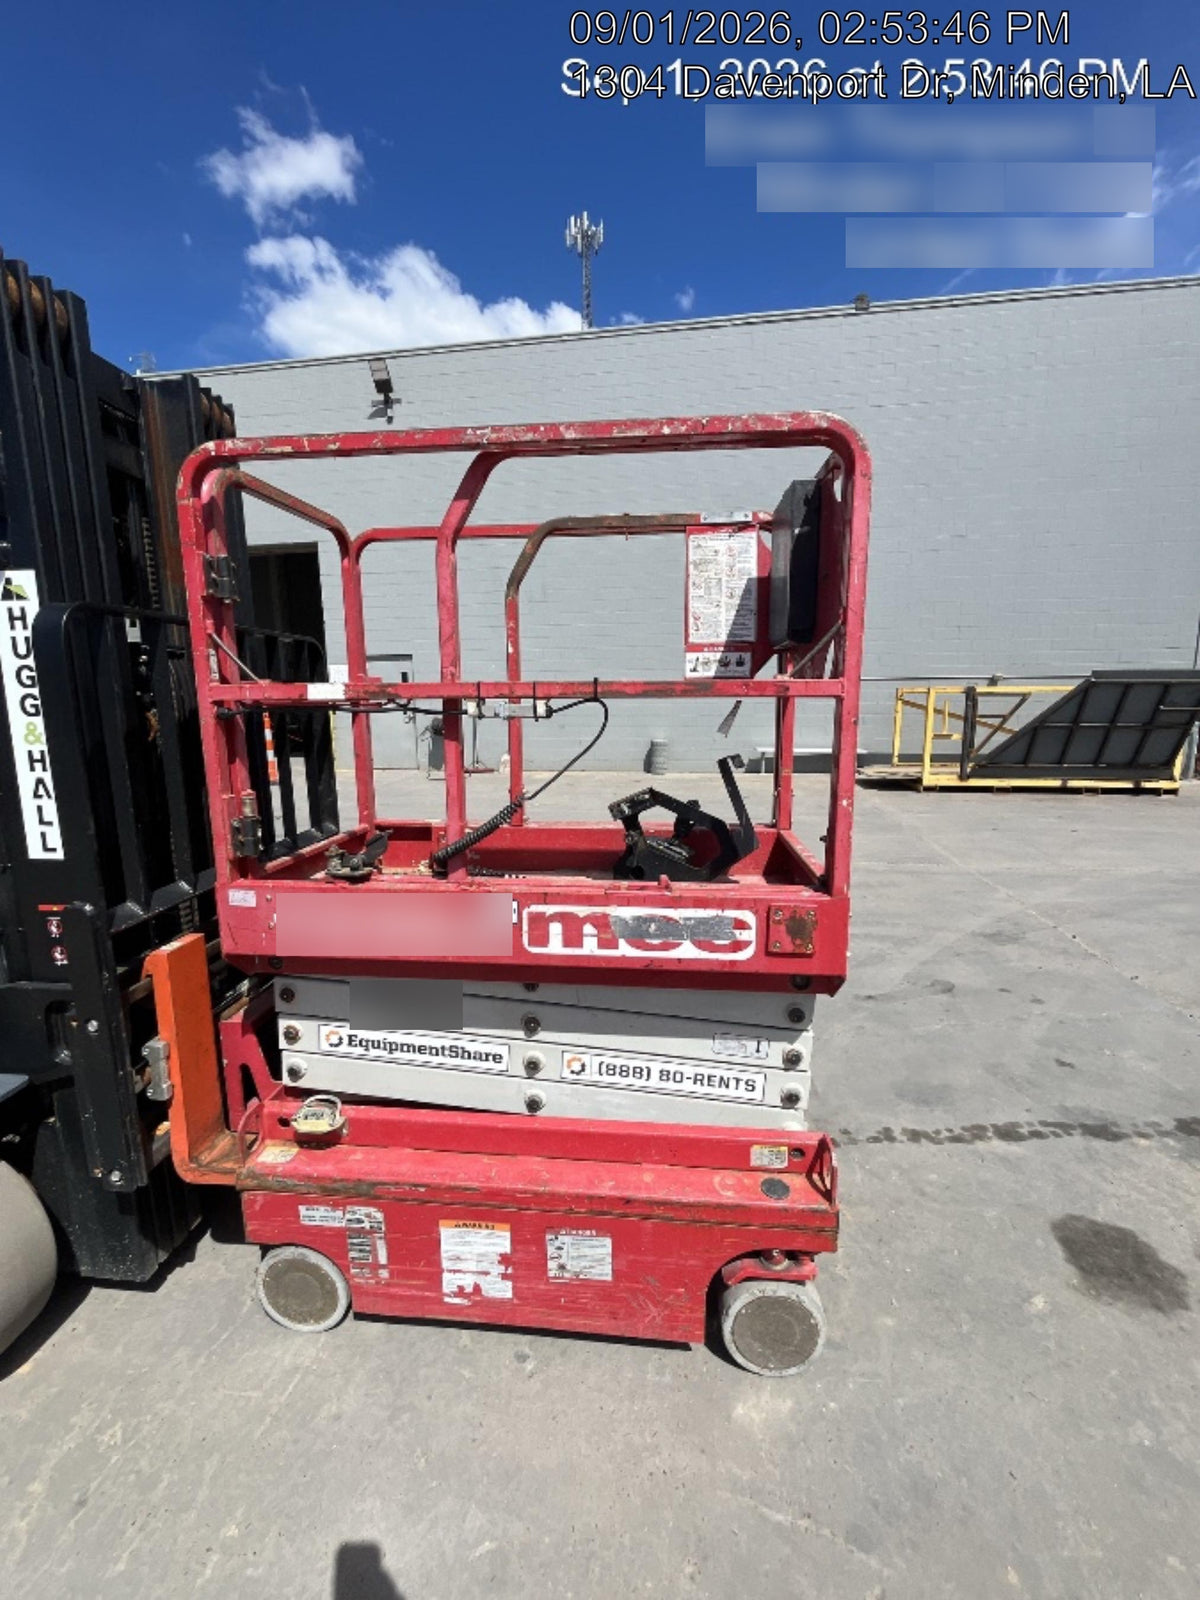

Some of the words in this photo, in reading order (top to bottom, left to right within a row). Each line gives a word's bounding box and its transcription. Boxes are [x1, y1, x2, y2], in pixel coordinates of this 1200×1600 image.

[347, 1034, 503, 1064] EquipmentShare
[598, 1061, 651, 1082] (888)
[659, 1068, 756, 1092] 80-RENTS
